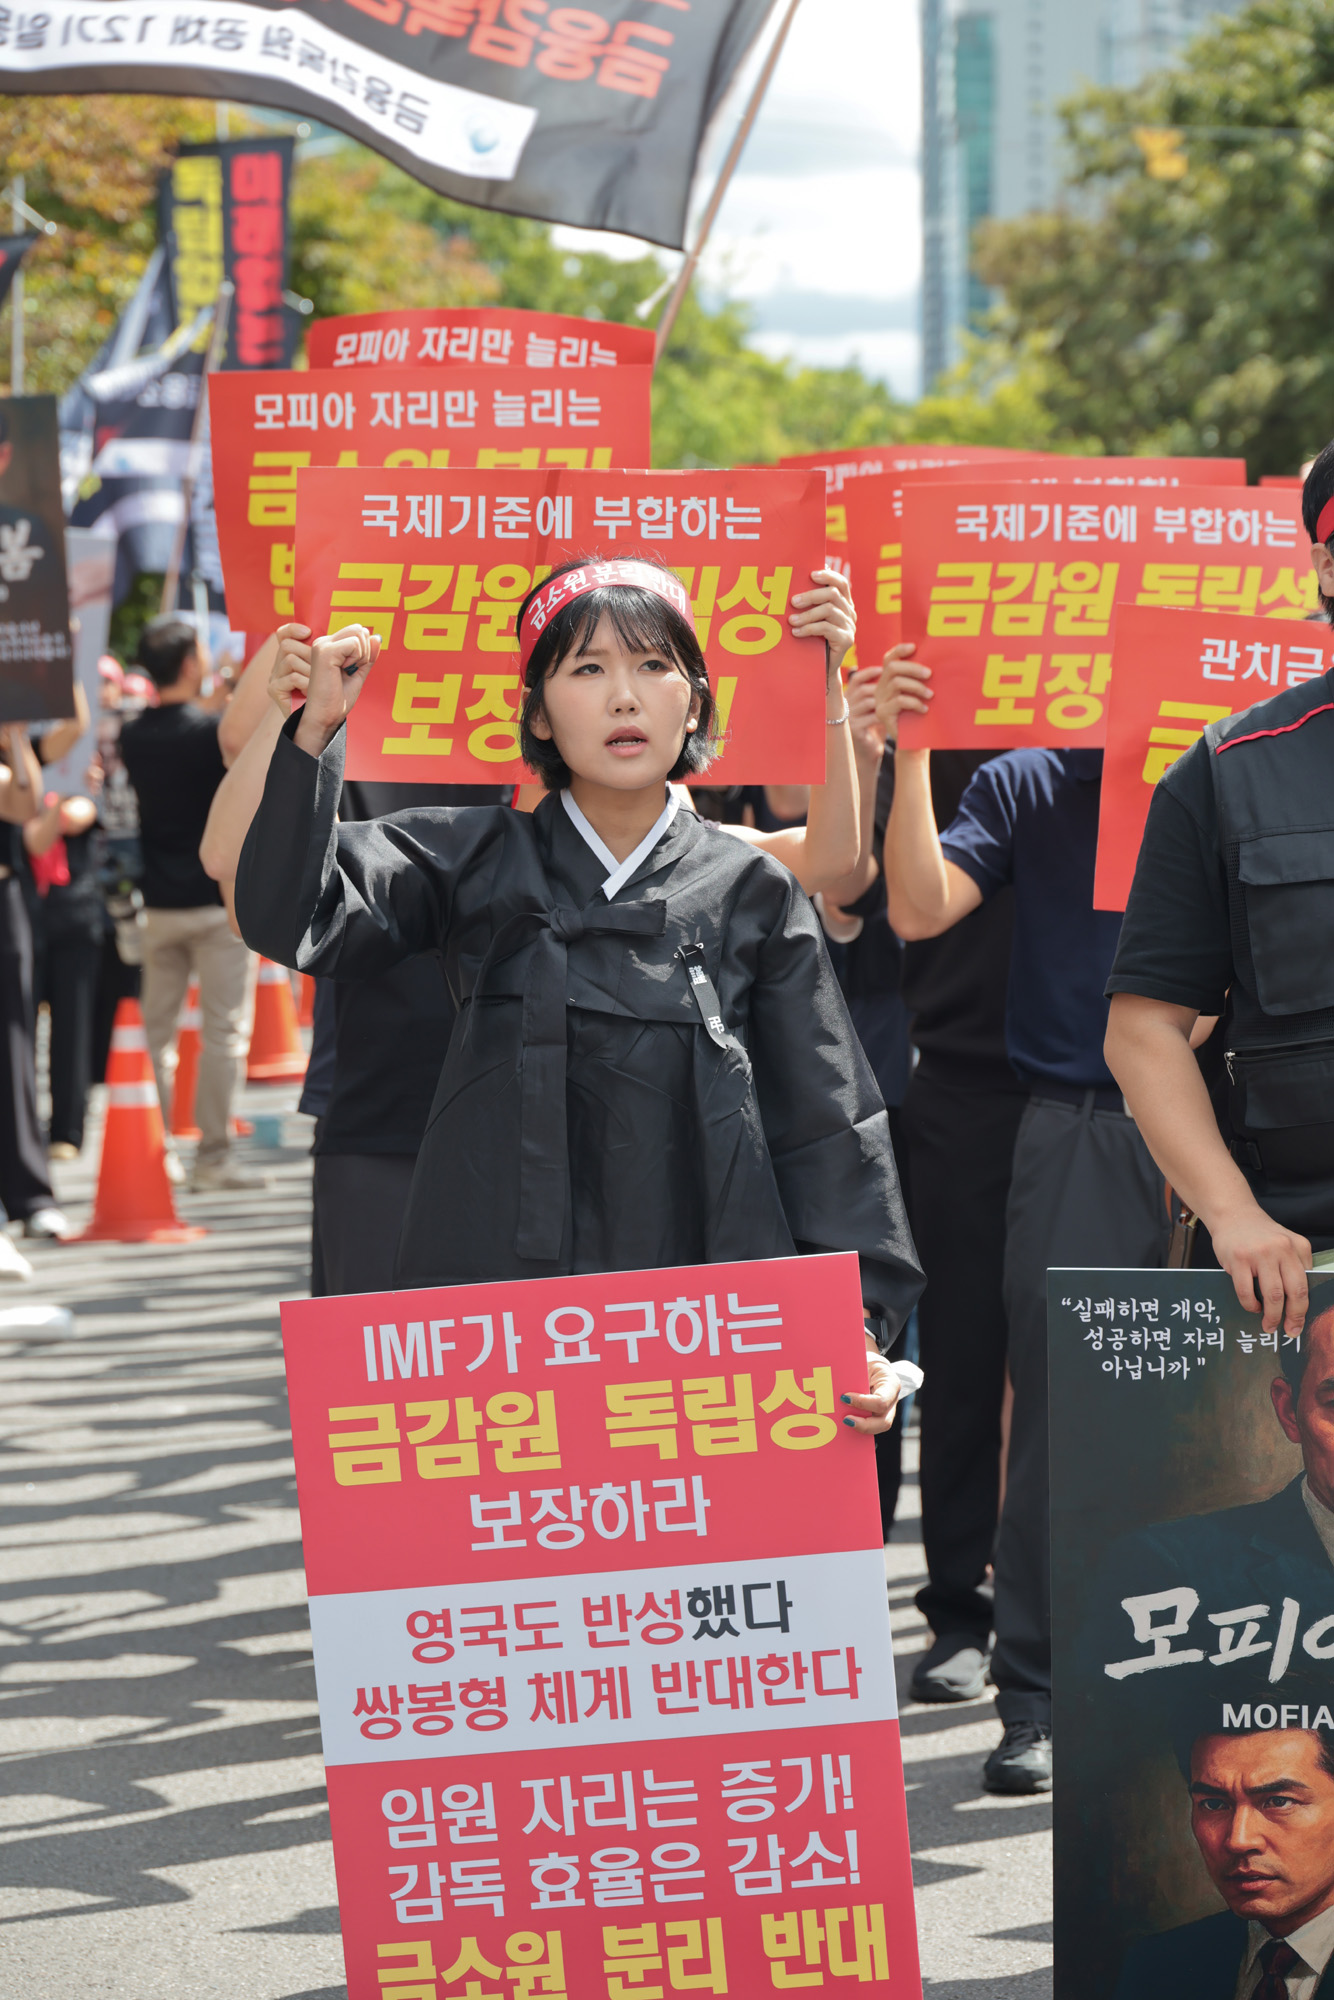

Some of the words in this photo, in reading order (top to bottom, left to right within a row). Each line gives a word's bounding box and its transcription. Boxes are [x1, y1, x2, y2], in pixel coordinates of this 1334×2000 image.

[333, 329, 409, 367] 모피아
[417, 327, 514, 365] 자리만
[525, 332, 617, 368] 늘리는
[254, 392, 356, 430] 모피아
[370, 391, 478, 429] 자리만
[493, 389, 601, 428] 늘리는
[361, 494, 572, 539] 국제기준에
[593, 496, 762, 540] 부합하는
[956, 504, 1137, 542] 국제기준에
[1153, 507, 1297, 547] 부합하는
[327, 563, 552, 652] 금감원
[528, 570, 591, 631] 금소원
[592, 563, 641, 584] 분리
[647, 568, 686, 614] 반대
[926, 561, 1120, 637] 금감원
[1200, 638, 1334, 687] 관치금
[363, 1311, 521, 1382] IMF가
[543, 1293, 783, 1366] 요구하는
[1083, 1326, 1171, 1351] 성공하면
[1182, 1327, 1224, 1352] 자리
[1236, 1328, 1301, 1354] 늘리기
[1170, 1298, 1221, 1323] 개악,
[328, 1390, 562, 1486] 금감원
[605, 1366, 838, 1460] 독립성
[470, 1476, 711, 1551] 보장하라
[406, 1600, 563, 1664] 영국도
[582, 1580, 793, 1647] 반성했다
[352, 1677, 508, 1740] 쌍봉형
[527, 1666, 631, 1724] 체계
[651, 1647, 862, 1715] 반대한다
[1222, 1704, 1334, 1729] MOFIA
[381, 1782, 498, 1849] 임원
[521, 1769, 698, 1836] 자리는
[721, 1754, 853, 1823] 증가!
[388, 1858, 506, 1924] 감독
[529, 1841, 705, 1910] 효율은
[727, 1830, 861, 1897] 감소!
[377, 1930, 568, 2000] 금소원
[602, 1917, 728, 2000] 분리
[761, 1904, 890, 1990] 반대
